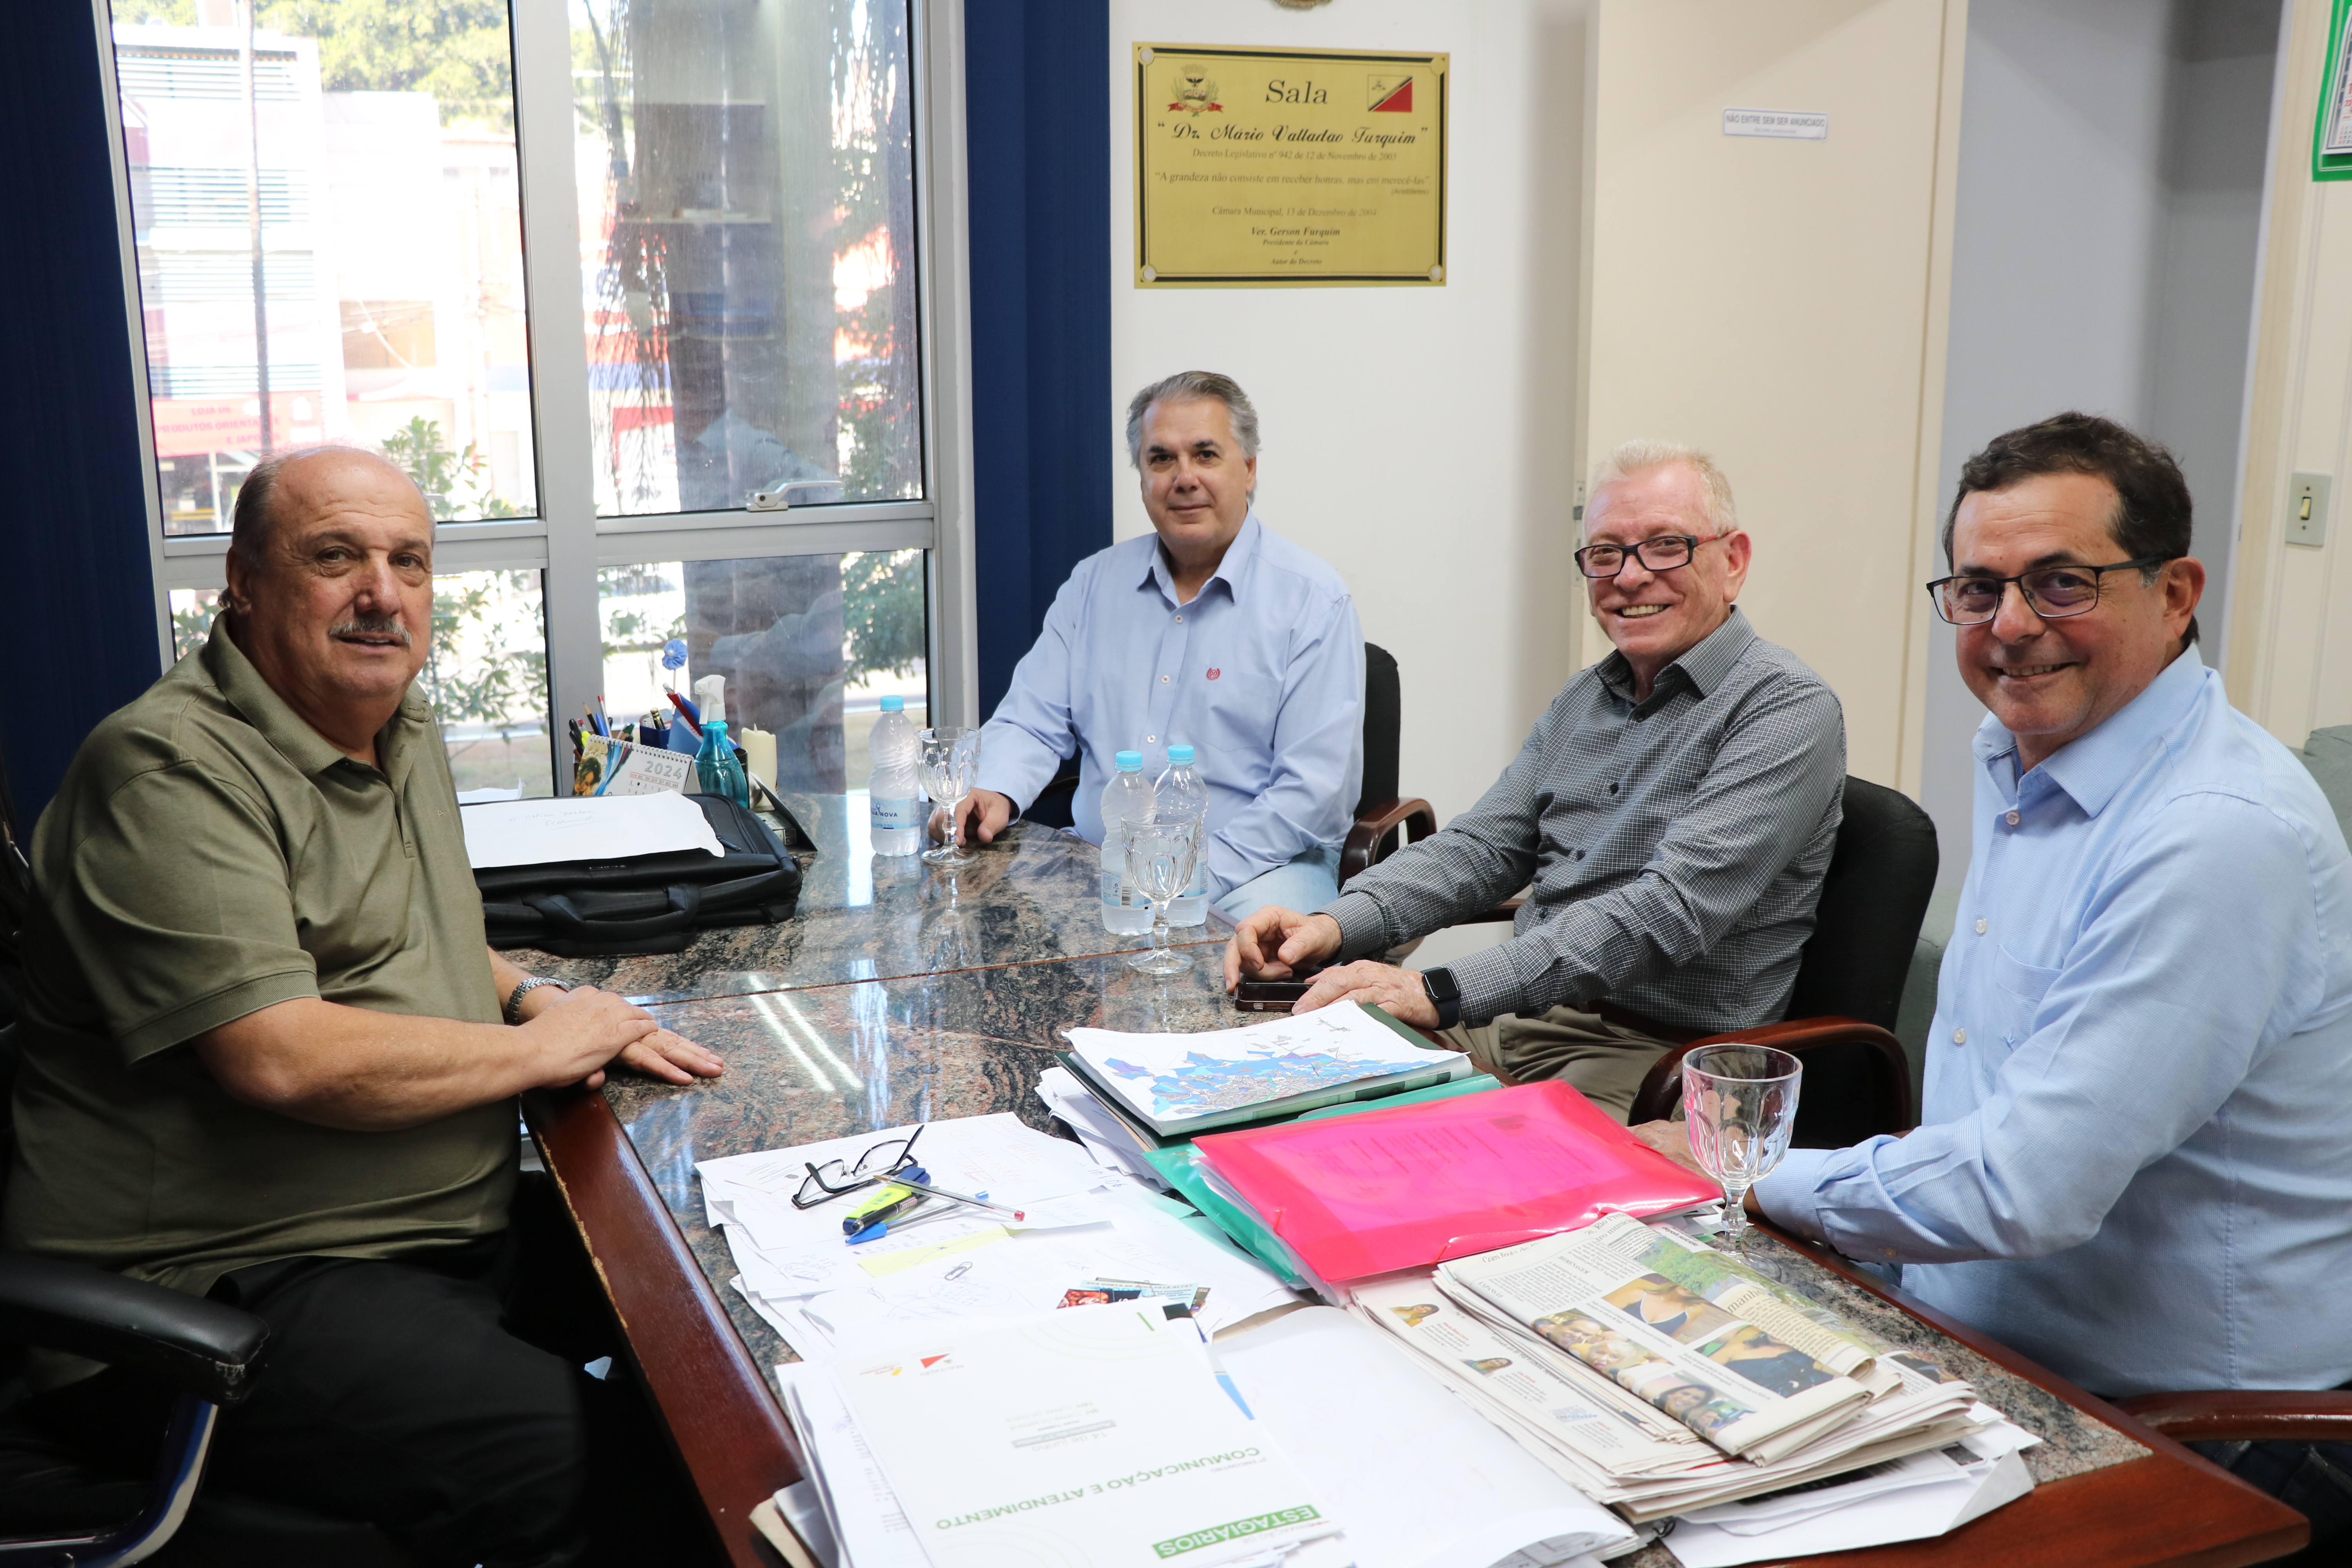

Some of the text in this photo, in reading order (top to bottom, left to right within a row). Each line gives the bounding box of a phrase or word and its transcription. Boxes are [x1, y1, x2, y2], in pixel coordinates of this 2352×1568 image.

[1266, 80, 1328, 104] Sala
[1726, 113, 1825, 127] NÃO ENTRE SEM SER ANUNCIADO
[1172, 122, 1200, 140] Dr.
[1210, 123, 1264, 140] Mário
[1193, 149, 1223, 157] Decreto
[1225, 149, 1266, 159] Legislativo
[1279, 151, 1292, 159] 942
[1295, 151, 1303, 160] de
[1328, 152, 1366, 160] Novembro
[1170, 172, 1209, 183] grandeza
[1212, 174, 1227, 182] não
[1230, 174, 1263, 183] consiste
[1282, 175, 1312, 183] receber
[1212, 206, 1241, 216] Câmara
[1244, 207, 1284, 218] Municipal,
[1287, 208, 1294, 216] 13
[1297, 208, 1306, 216] de
[1308, 208, 1345, 217] Dezembro
[1348, 208, 1357, 216] de
[1252, 227, 1341, 238] Ver. Gerson Furquim
[192, 407, 216, 416] LOJA
[157, 422, 213, 433] PRODUTOS
[645, 760, 682, 779] 2024
[1558, 1255, 1590, 1274] HOMENAGEM
[1478, 1281, 1504, 1299] EXPANSÃO
[1092, 1431, 1107, 1439] 14
[1031, 1437, 1069, 1451] junho
[936, 1447, 1260, 1530] COMUNICAÇÃO E ATENDIMENTO
[1157, 1505, 1316, 1556] ESTAGIÁRIOS
